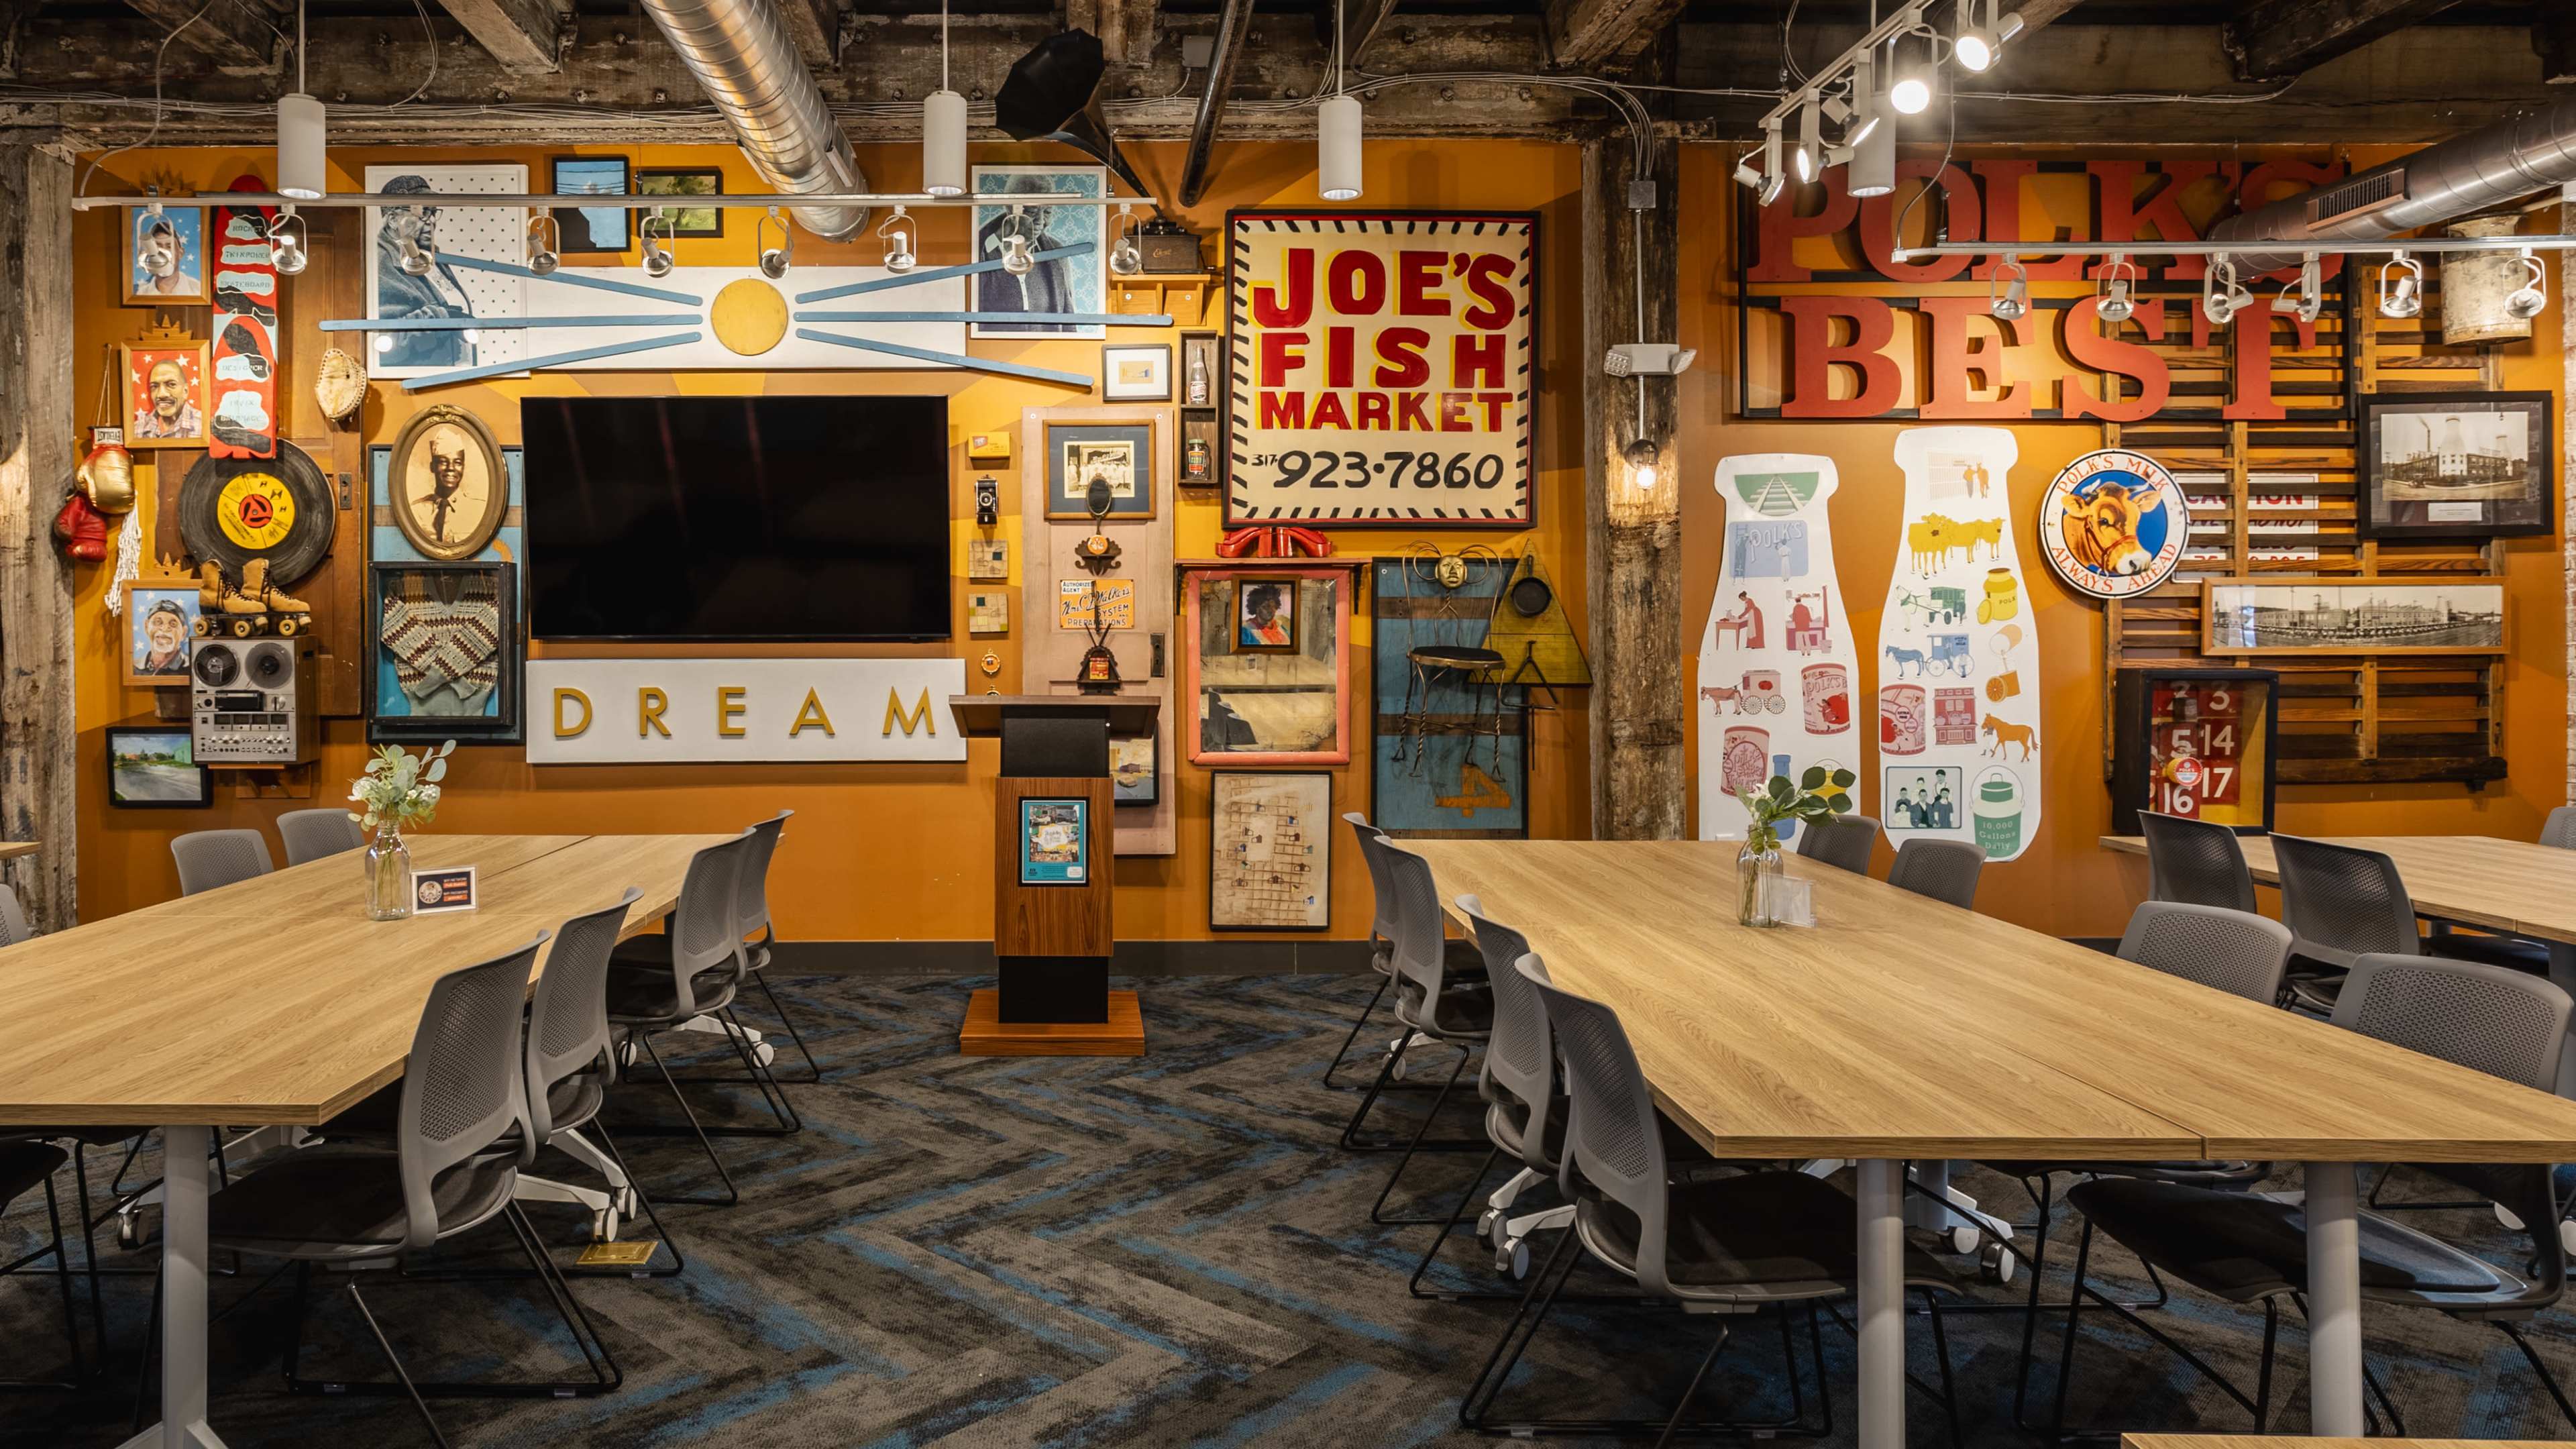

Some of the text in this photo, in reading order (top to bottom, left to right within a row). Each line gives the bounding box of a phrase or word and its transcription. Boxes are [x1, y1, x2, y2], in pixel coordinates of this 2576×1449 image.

[1252, 248, 1515, 331] JOE'S
[1256, 326, 1506, 388] FISH
[1780, 295, 2317, 421] BEST
[1256, 391, 1513, 433] MARKET
[2125, 458, 2169, 492] MILK
[1749, 522, 1803, 563] POLK'S
[2051, 544, 2177, 592] ALWAYS AHEAD
[1067, 618, 1126, 627] PREPAATIONS
[554, 686, 936, 737] DREAM
[2204, 724, 2235, 756] 14
[2164, 767, 2233, 814] 16 17
[1979, 830, 2017, 840] Gallons
[1982, 821, 2012, 830] 10,000
[1985, 841, 2010, 850] Daily
